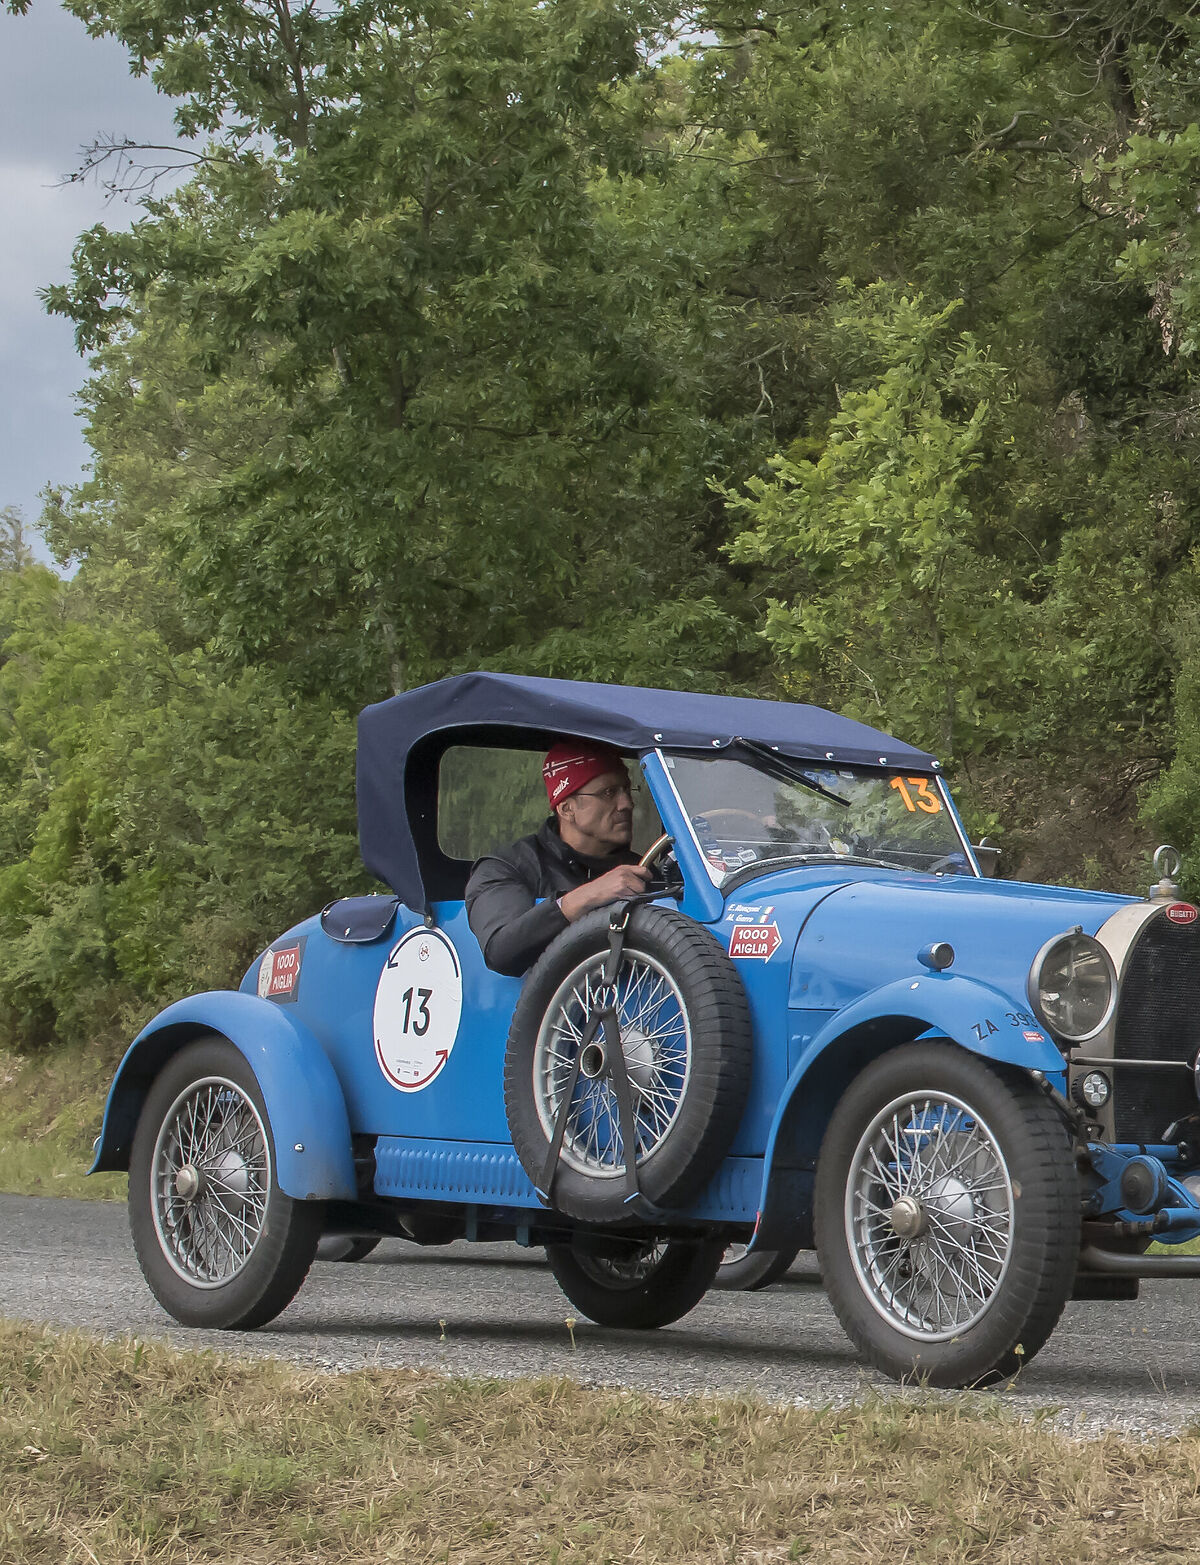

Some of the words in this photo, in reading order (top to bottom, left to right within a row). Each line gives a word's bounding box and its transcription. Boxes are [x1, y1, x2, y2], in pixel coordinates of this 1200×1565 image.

[890, 777, 940, 813] 13
[738, 929, 769, 940] 1000
[732, 943, 768, 954] MIGLIA
[277, 954, 295, 970] 1000
[272, 974, 293, 990] MIGLIA
[402, 987, 433, 1036] 13
[971, 1019, 999, 1040] ZA
